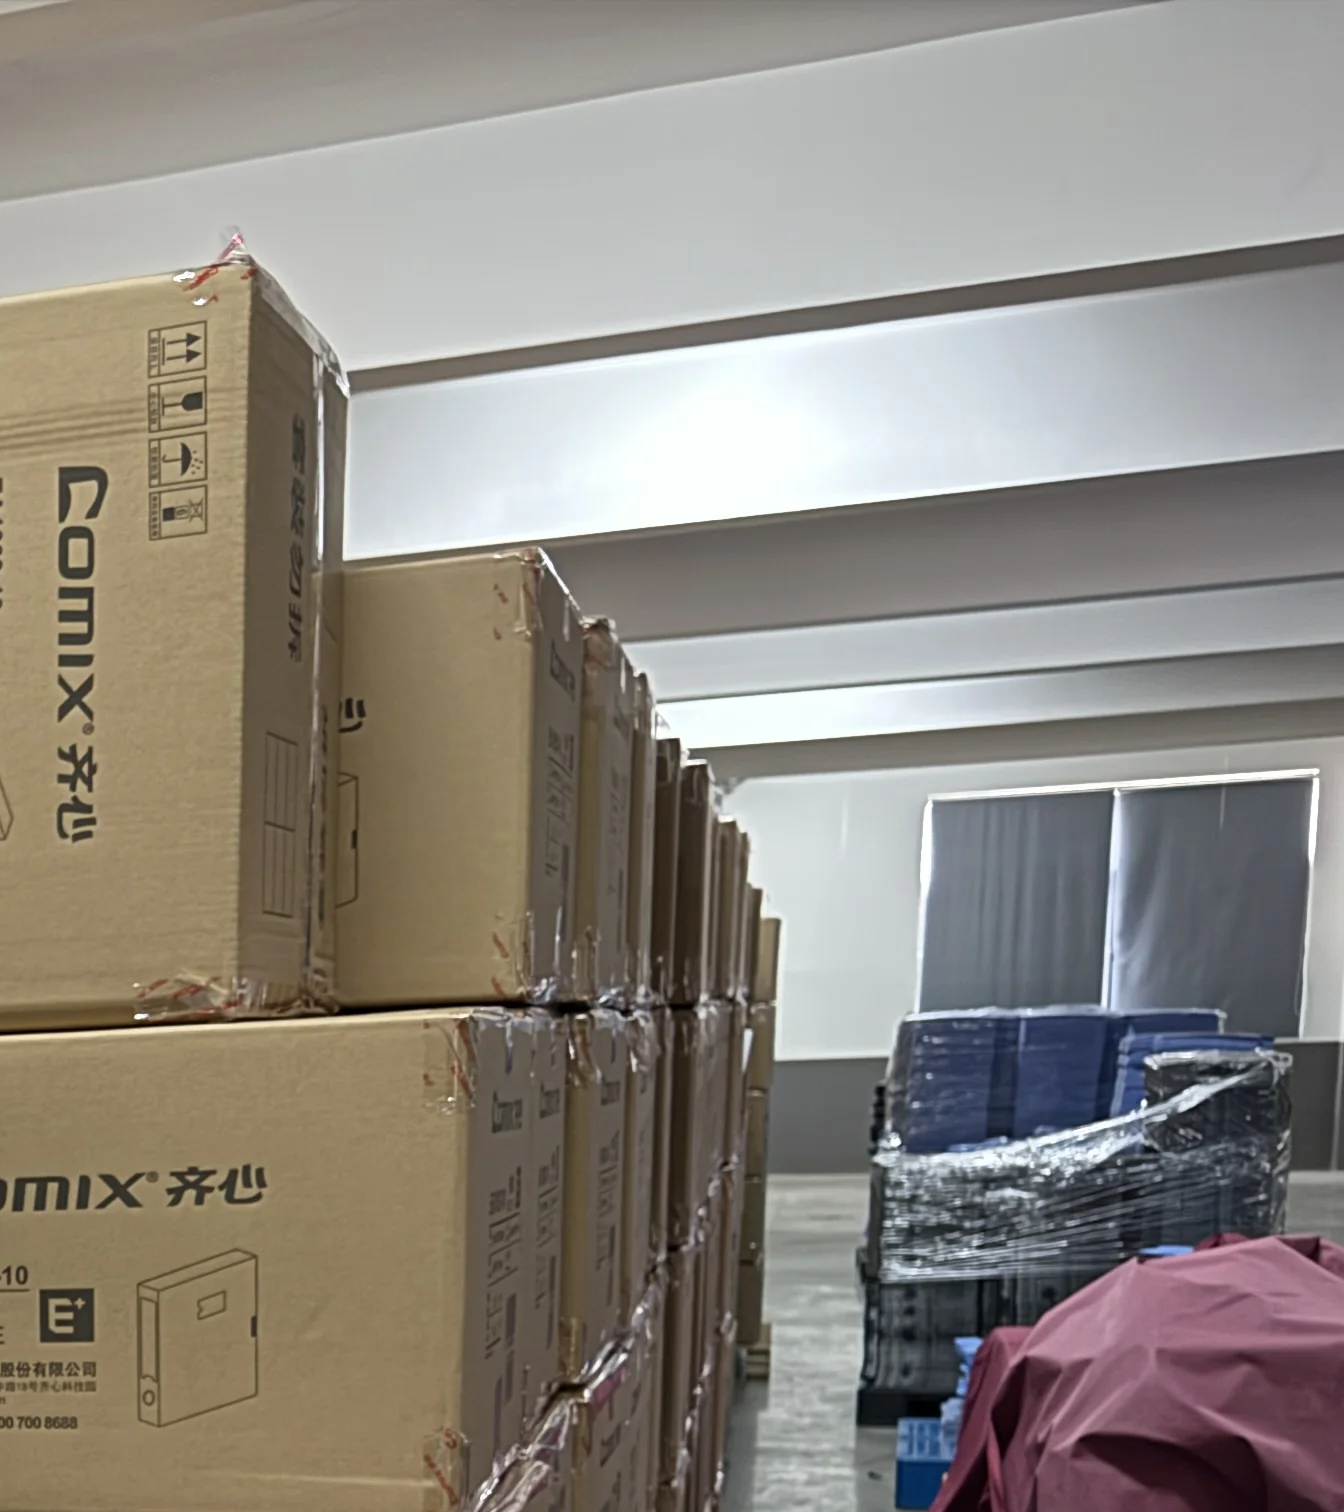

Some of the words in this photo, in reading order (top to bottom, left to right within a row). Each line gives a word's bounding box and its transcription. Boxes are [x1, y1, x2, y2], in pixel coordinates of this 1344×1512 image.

[57, 742, 99, 844] 齐心
[166, 1163, 268, 1209] 齐心
[17, 1416, 42, 1429] 700
[44, 1416, 78, 1429] 8688
